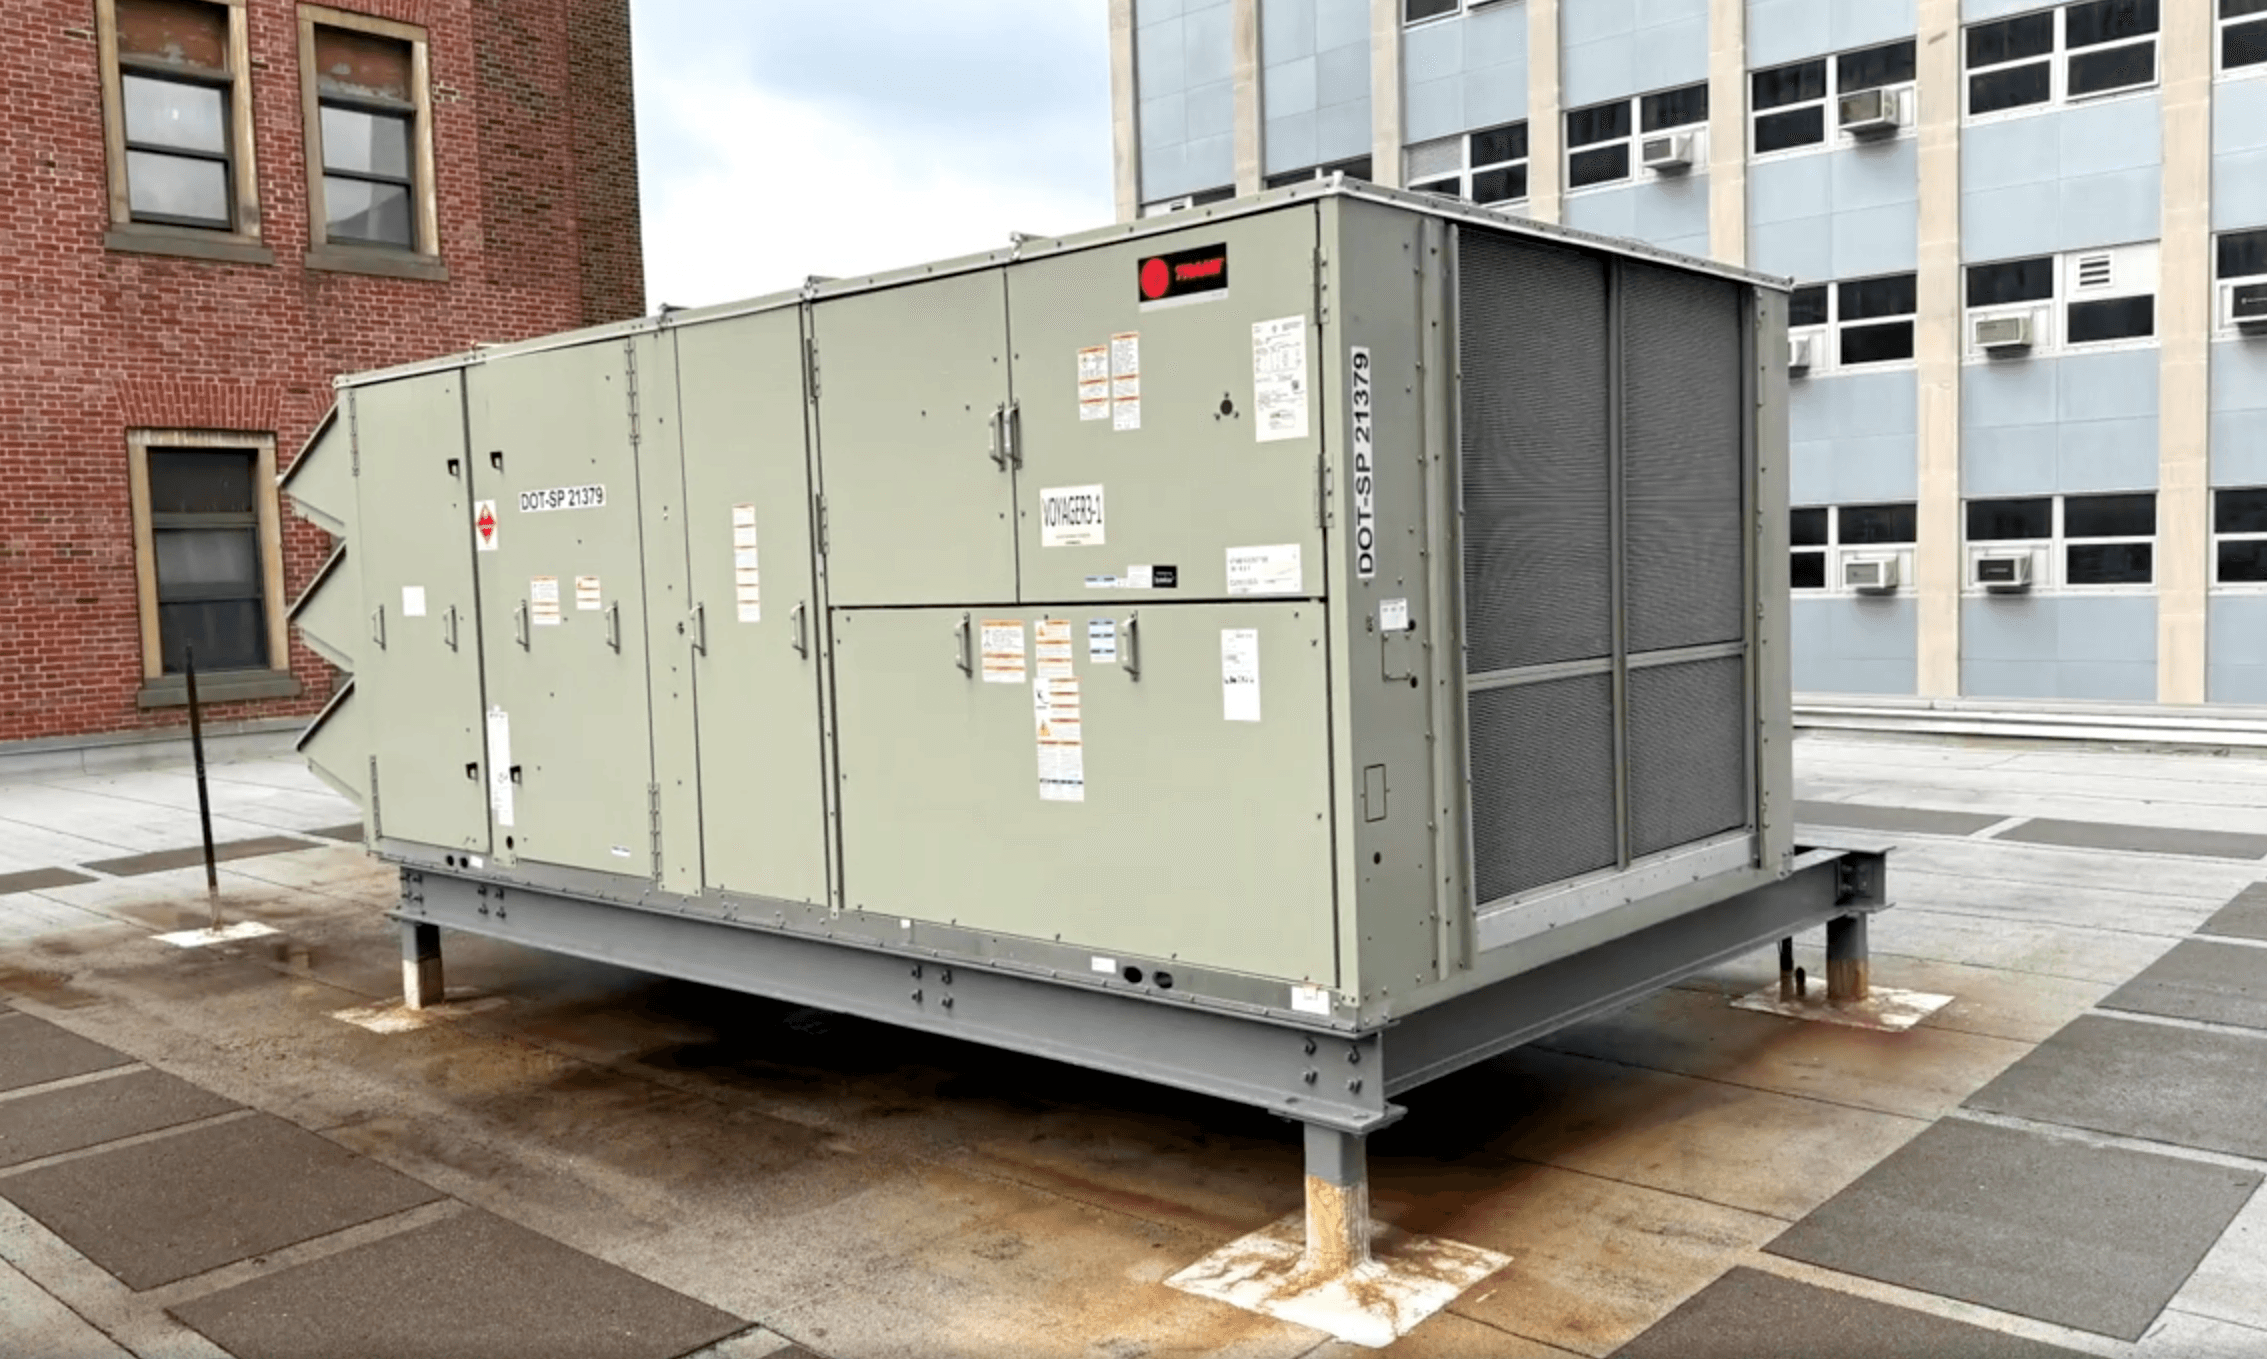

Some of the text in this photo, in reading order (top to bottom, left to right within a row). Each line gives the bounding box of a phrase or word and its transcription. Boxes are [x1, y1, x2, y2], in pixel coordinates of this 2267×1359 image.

[1353, 352, 1374, 574] DOT-SP 21379
[521, 486, 603, 510] DOT-SP 21379
[1042, 494, 1102, 527] VOYAGER3-1
